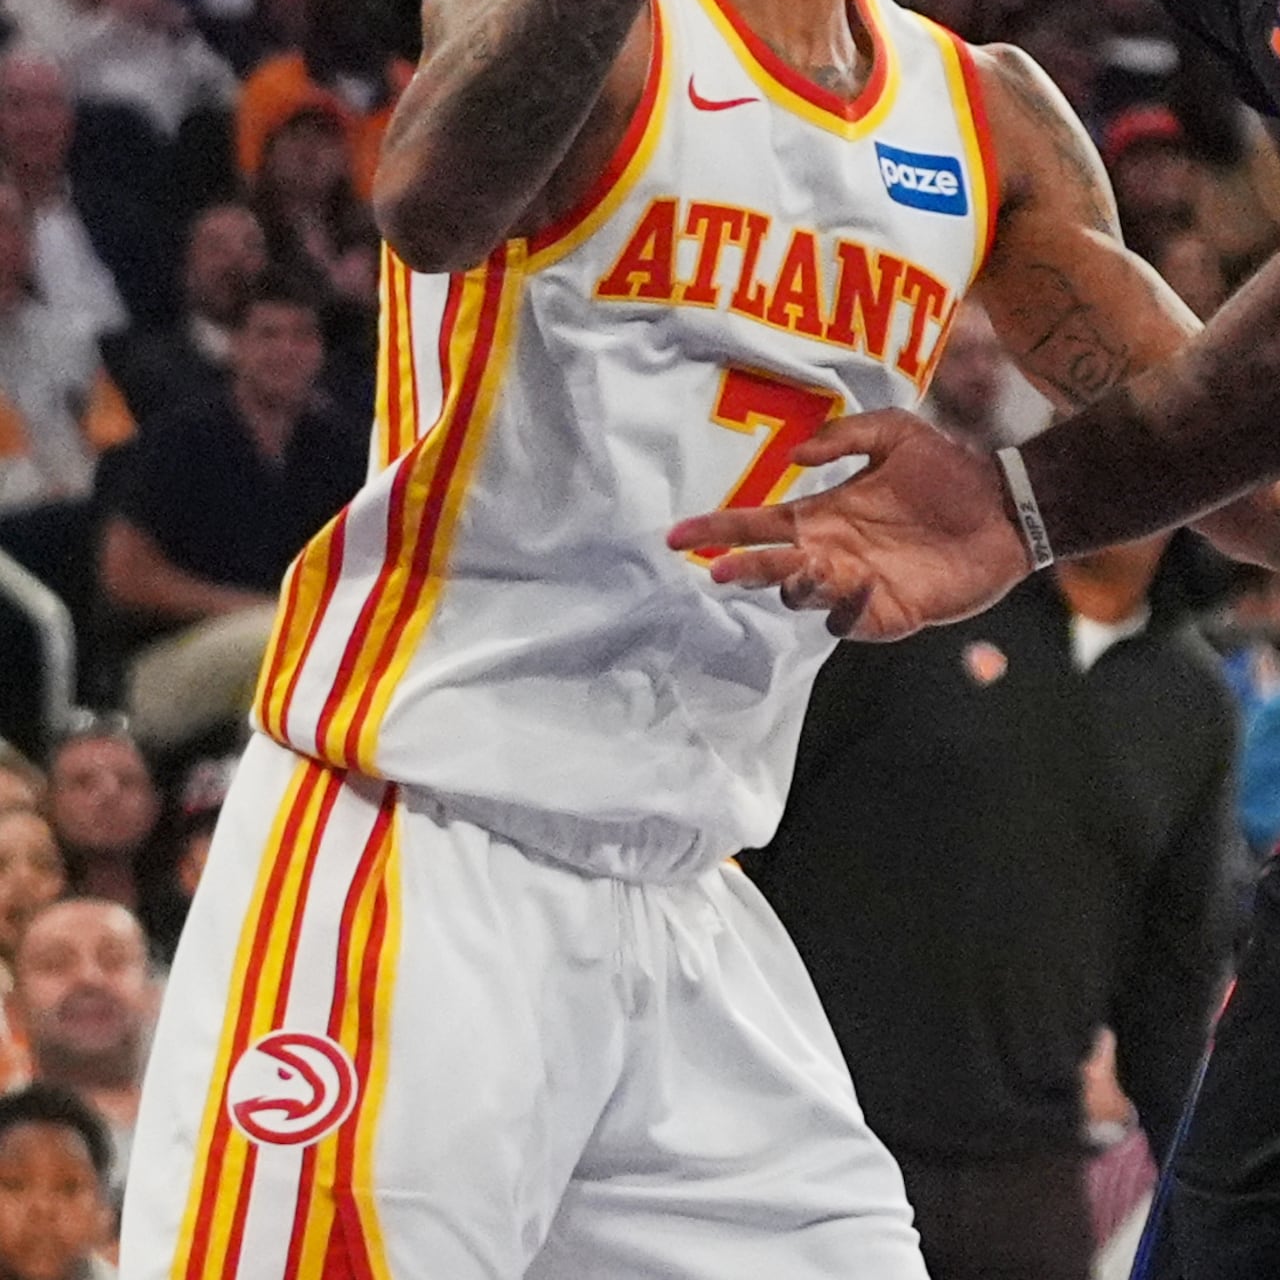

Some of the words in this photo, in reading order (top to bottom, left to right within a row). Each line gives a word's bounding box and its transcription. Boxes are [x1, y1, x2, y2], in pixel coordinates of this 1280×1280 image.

[880, 156, 960, 196] paze
[595, 196, 959, 401] ATLANT
[687, 363, 845, 566] 7
